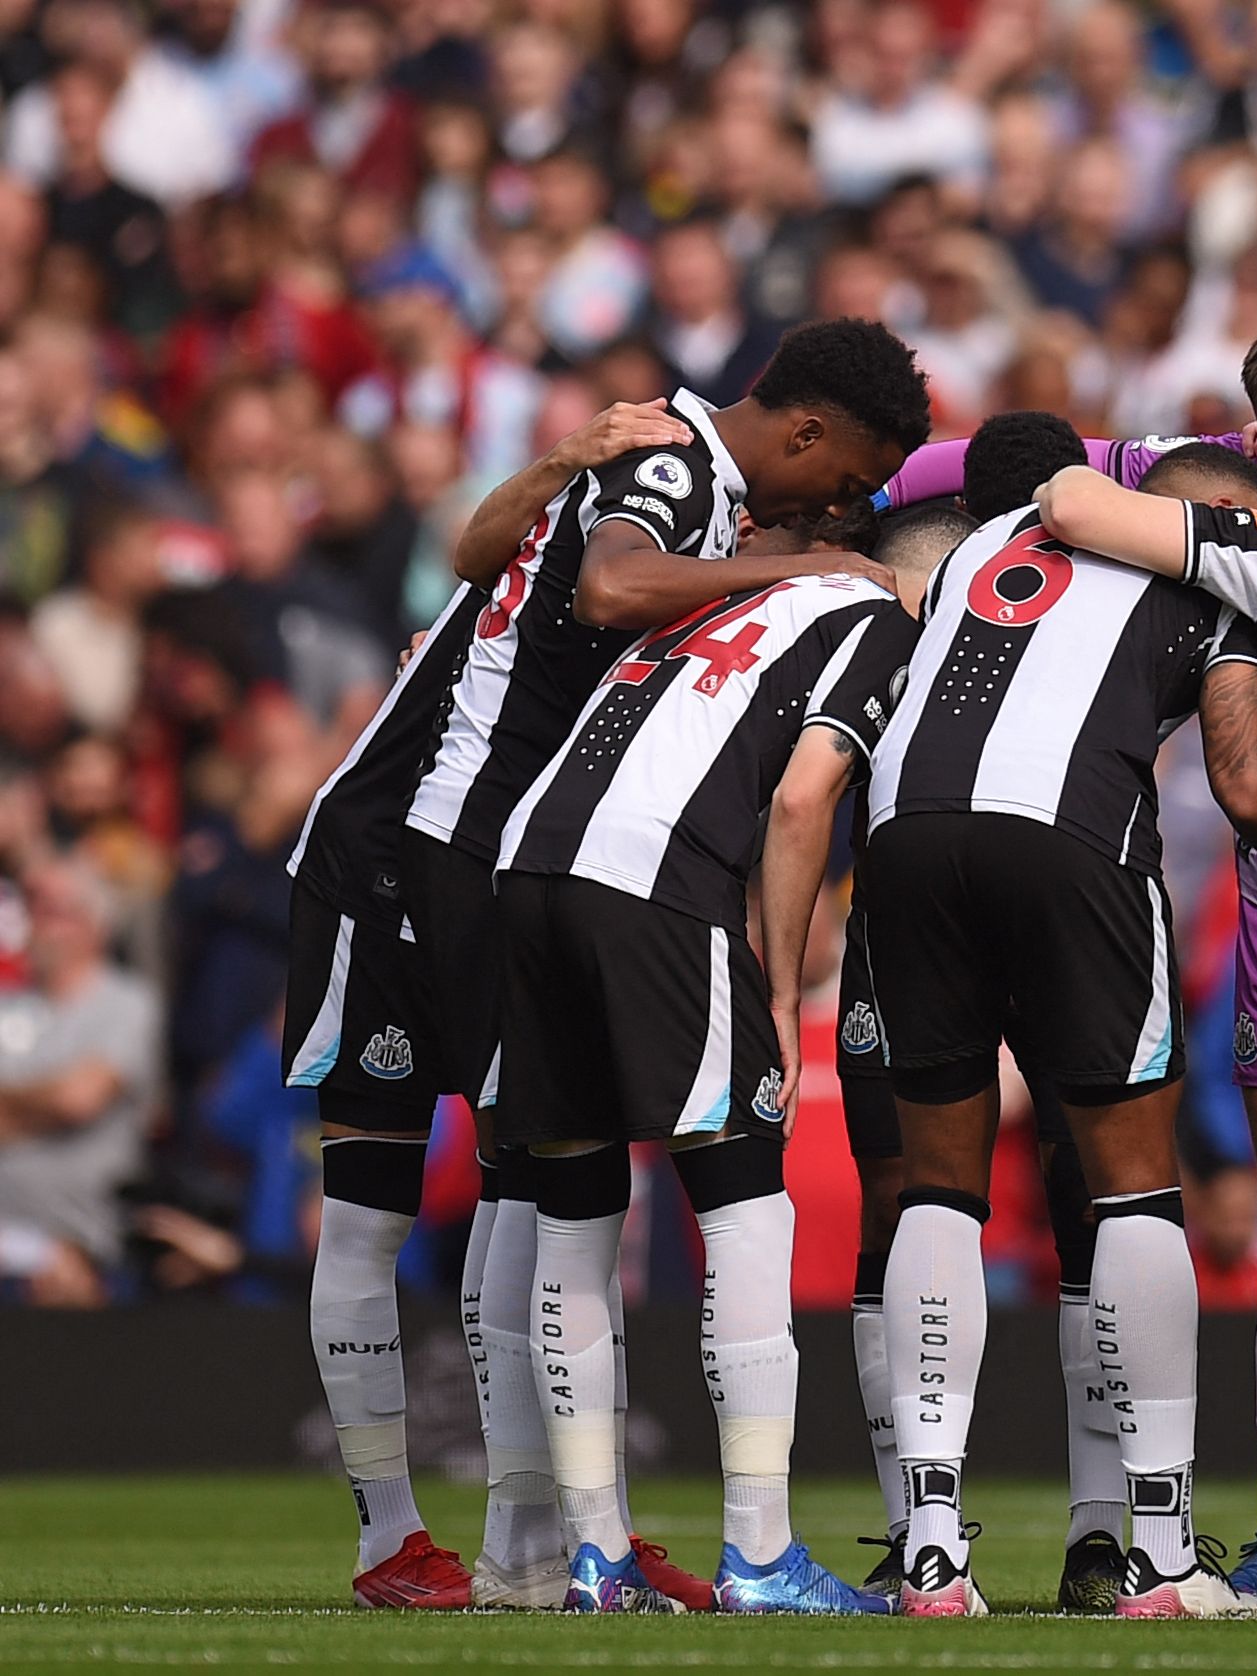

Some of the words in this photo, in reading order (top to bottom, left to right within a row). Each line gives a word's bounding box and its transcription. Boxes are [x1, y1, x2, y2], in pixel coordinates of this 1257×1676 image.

[965, 523, 1076, 627] 6
[542, 1281, 574, 1418] CASTORE
[701, 1269, 725, 1403] CASTORE
[919, 1295, 949, 1424] CASTORE
[1094, 1299, 1137, 1434] CASTORE
